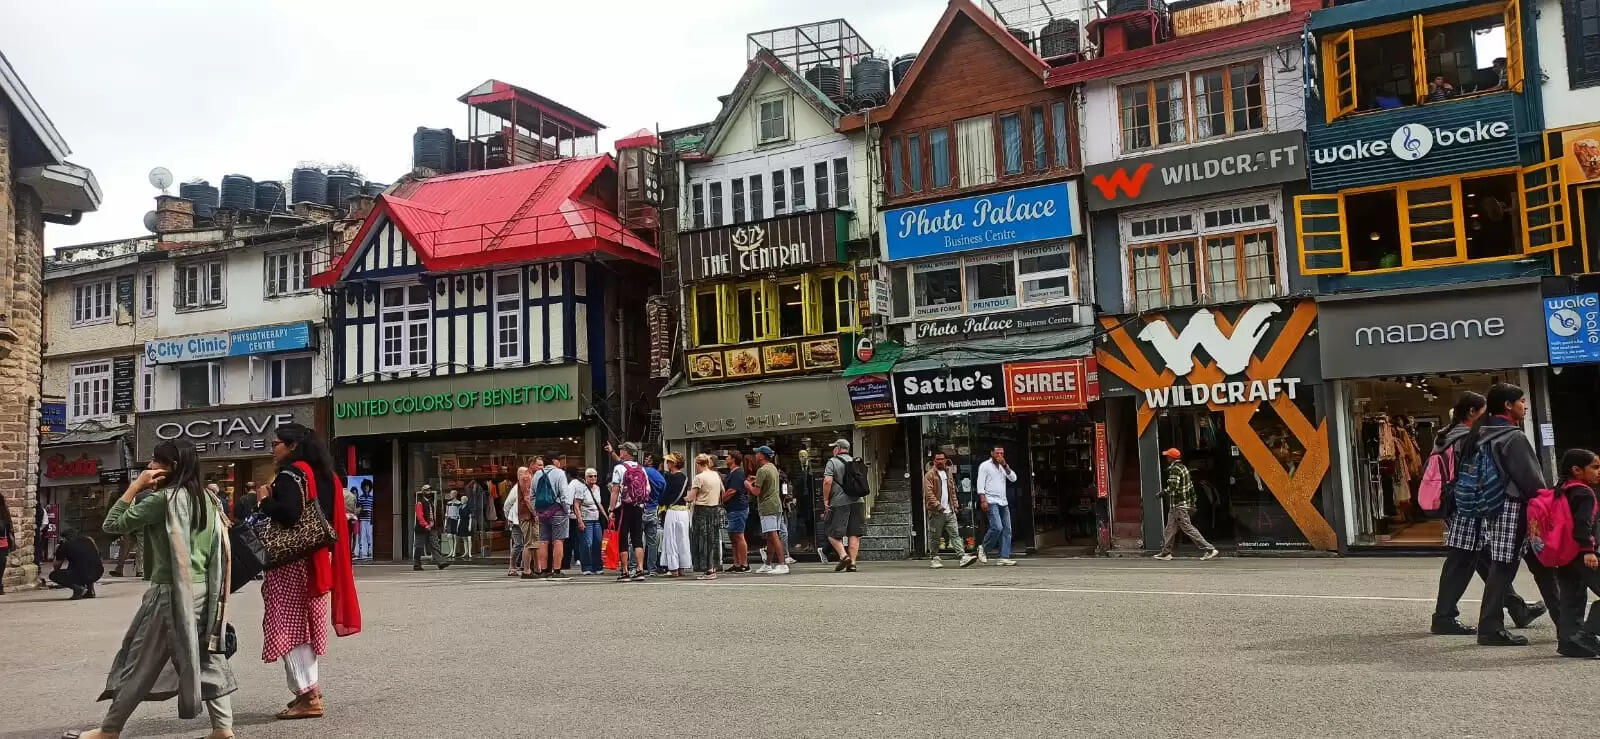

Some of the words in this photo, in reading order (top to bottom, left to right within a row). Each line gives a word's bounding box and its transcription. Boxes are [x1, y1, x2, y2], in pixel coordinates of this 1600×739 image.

[1314, 139, 1388, 164] wake
[1436, 120, 1509, 146] bake
[898, 209, 965, 239] Photo
[972, 194, 1057, 227] Palace
[944, 231, 983, 248] Business
[984, 229, 1016, 243] Centre
[702, 254, 730, 276] THE
[741, 242, 810, 271] CENTRAL
[1022, 244, 1065, 256] PHOTOSTAT
[940, 304, 961, 313] FORMS
[973, 299, 1010, 309] PRINTOUT
[1548, 296, 1597, 310] wake
[232, 328, 289, 343] PHYSIOTHERAPY
[918, 322, 959, 339] Photo
[962, 316, 1014, 334] Palace
[1017, 319, 1047, 328] Business
[1048, 315, 1072, 325] Centre
[1585, 312, 1600, 344] bake
[157, 342, 184, 359] City
[188, 337, 227, 354] Clinic
[249, 340, 276, 351] CENTRE
[1014, 371, 1076, 394] SHREE
[1144, 377, 1301, 409] WILDCRAFT
[335, 399, 390, 420] UNITED
[392, 393, 453, 414] COLORS
[456, 391, 479, 409] OF
[906, 402, 947, 412] Munshiram
[948, 397, 995, 409] Nanakchand
[684, 418, 736, 435] LOUIS
[745, 408, 833, 430] PHILIPPE
[195, 439, 265, 452] ETTLE
